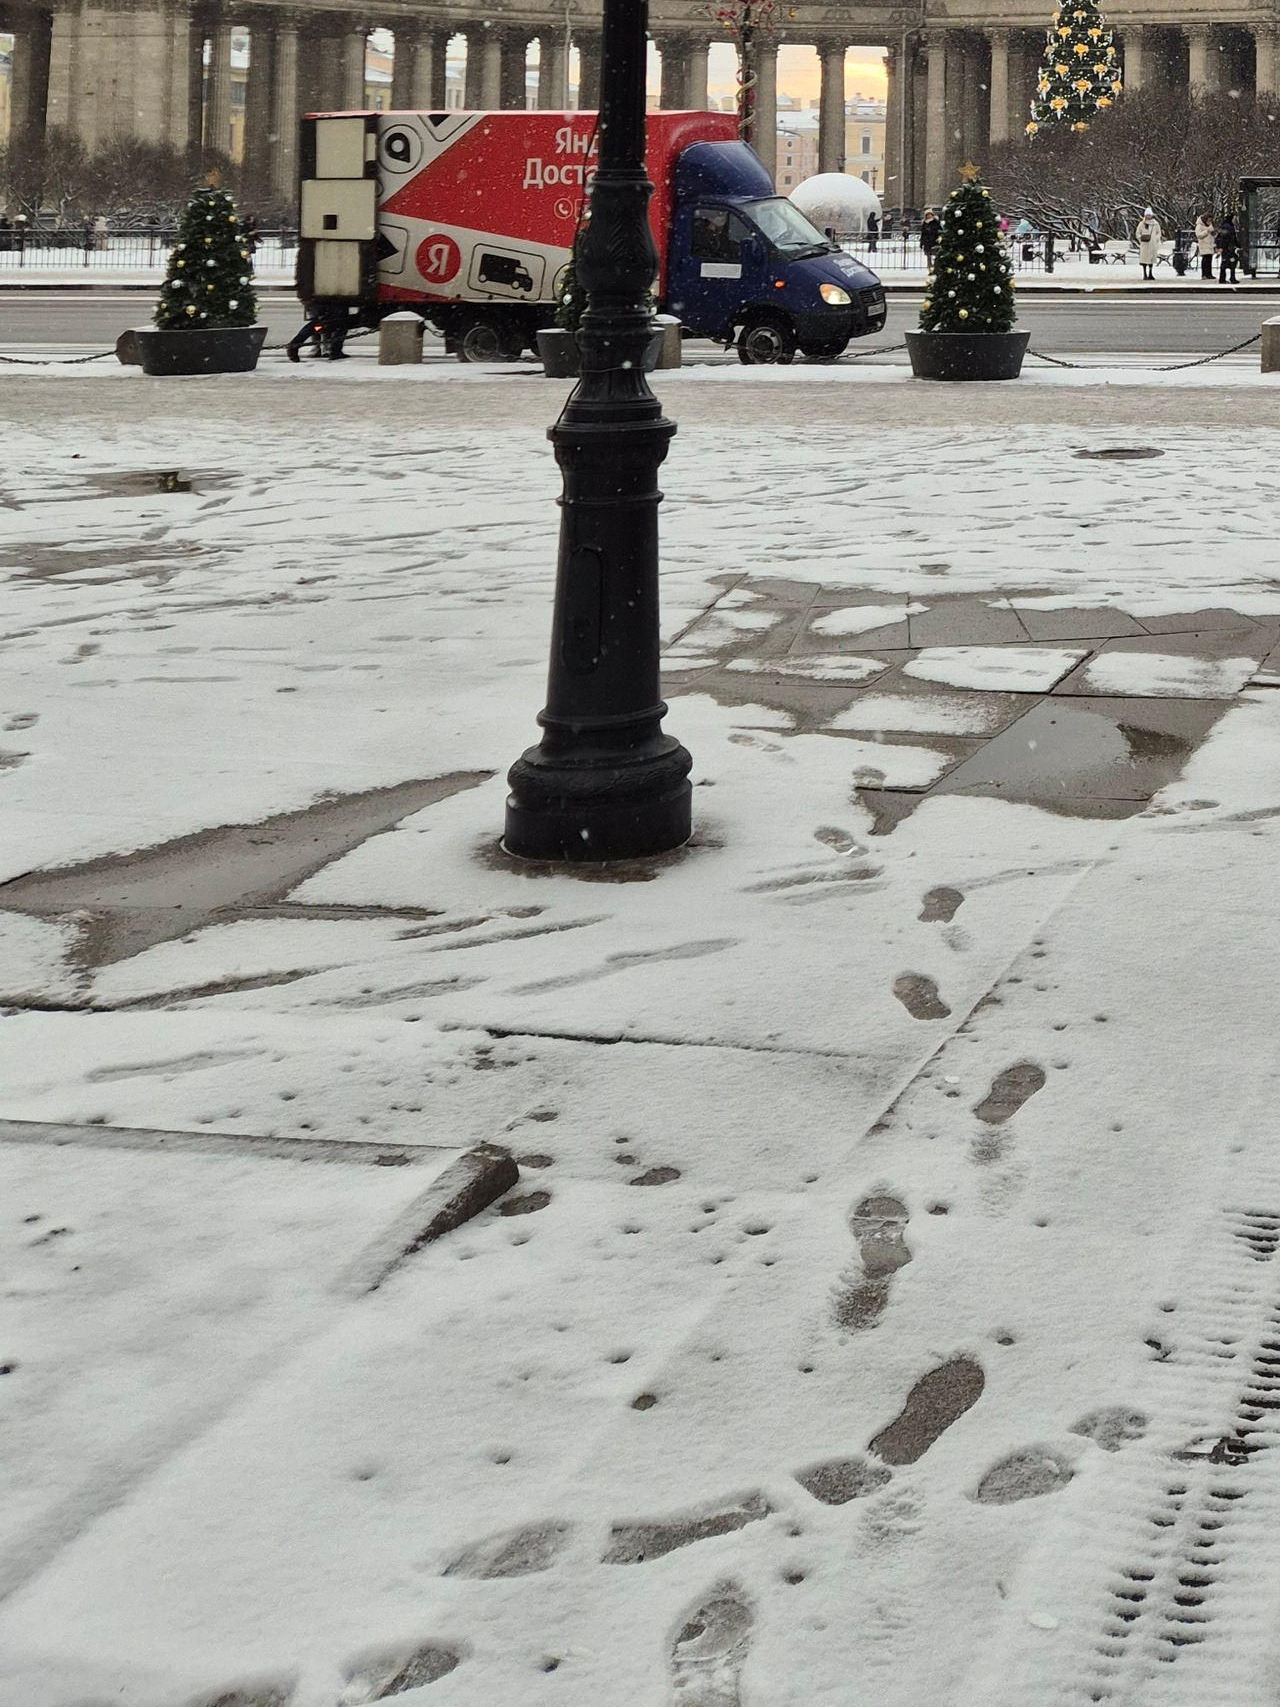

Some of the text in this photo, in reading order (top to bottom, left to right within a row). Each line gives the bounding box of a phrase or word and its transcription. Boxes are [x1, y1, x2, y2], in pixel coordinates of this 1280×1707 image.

[555, 126, 599, 158] Янд
[522, 157, 599, 190] Доста
[425, 243, 450, 276] Я
